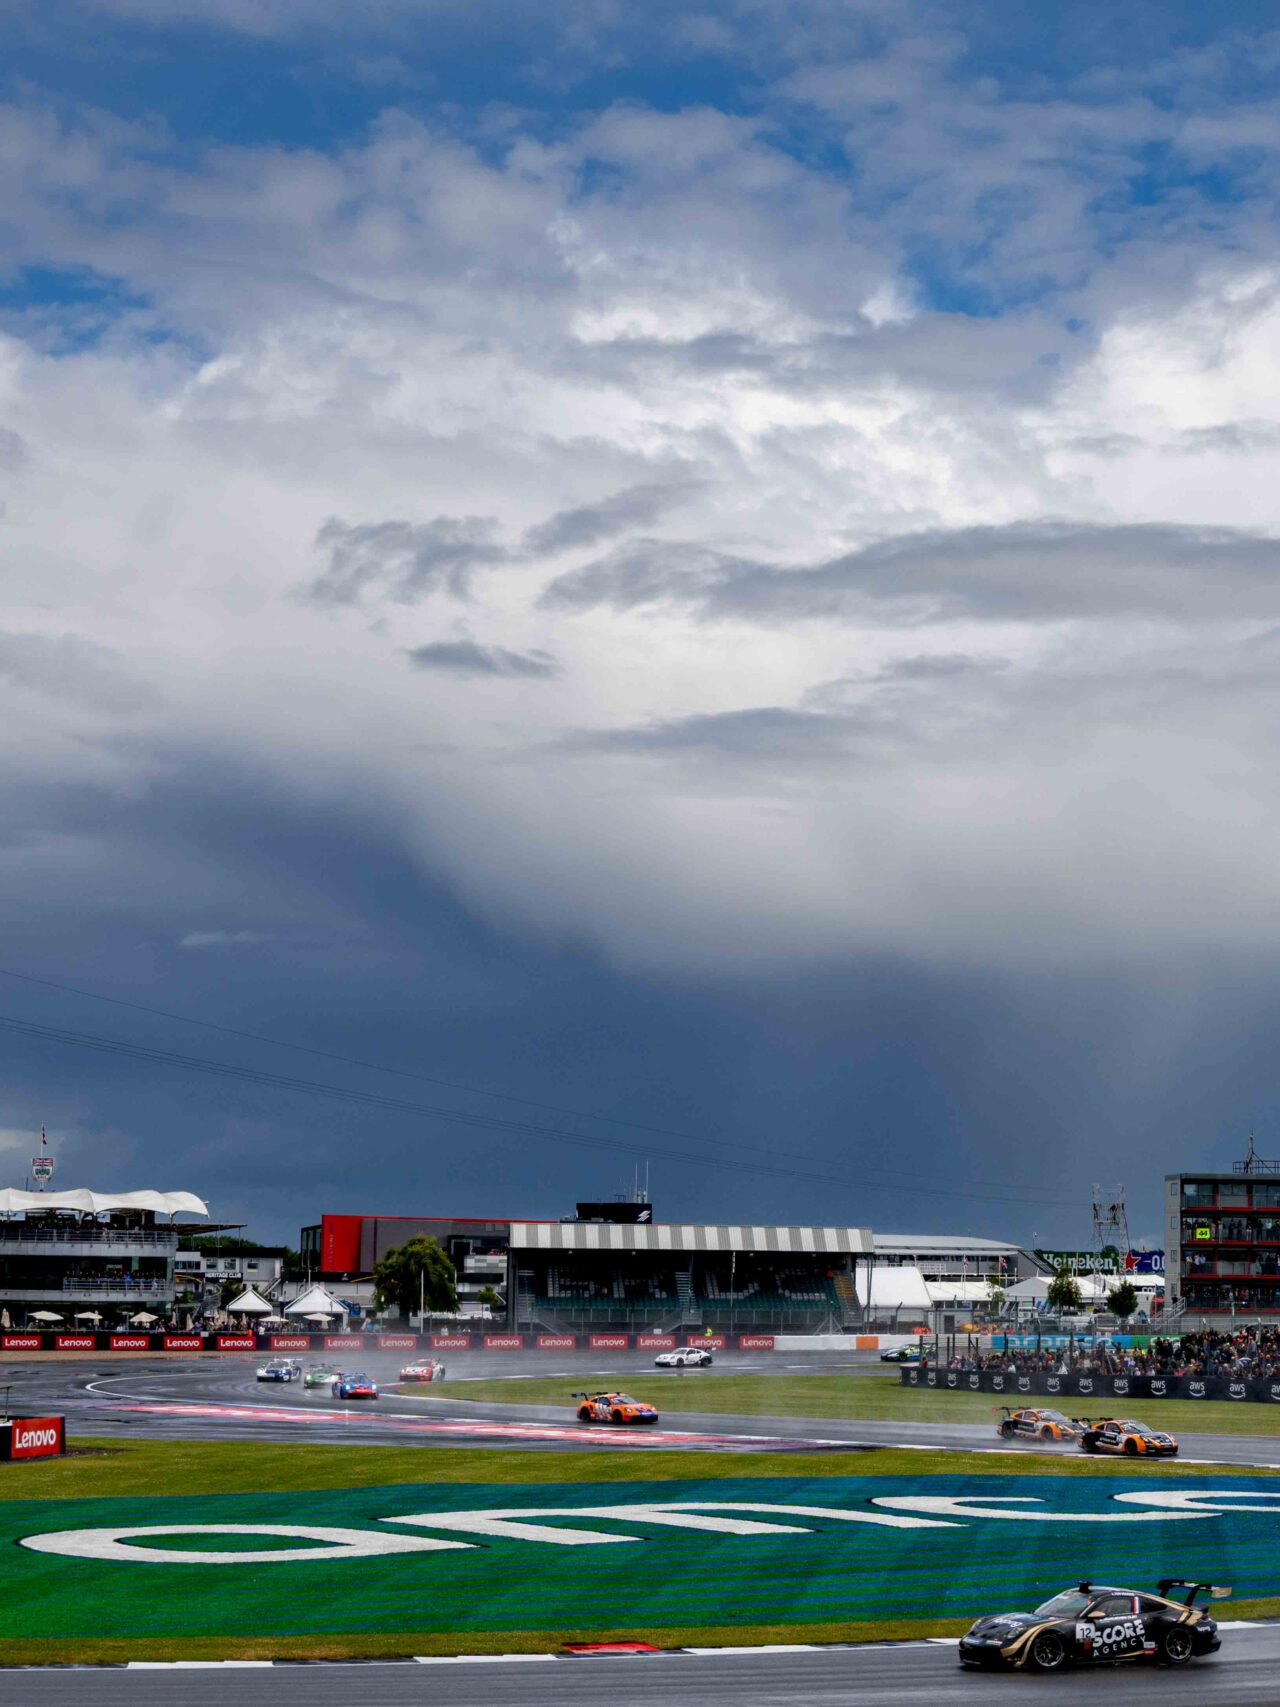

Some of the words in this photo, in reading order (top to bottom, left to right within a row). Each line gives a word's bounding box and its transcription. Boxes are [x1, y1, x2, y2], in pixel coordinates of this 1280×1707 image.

[1043, 1253, 1113, 1270] Heineken
[5, 1339, 37, 1347] Lenovo
[59, 1339, 91, 1347] Lenovo
[113, 1339, 145, 1347] Lenovo
[167, 1339, 199, 1347] Lenovo
[220, 1339, 253, 1347] Lenovo
[274, 1339, 307, 1347] Lenovo
[327, 1339, 360, 1347] Lenovo
[381, 1339, 413, 1347] Lenovo
[434, 1339, 466, 1347] Lenovo
[487, 1339, 519, 1347] Lenovo
[540, 1339, 572, 1347] Lenovo
[592, 1339, 624, 1347] Lenovo
[640, 1339, 672, 1347] Lenovo
[690, 1339, 722, 1347] Lenovo
[743, 1339, 772, 1347] Lenovo
[15, 1428, 57, 1448] Lenovo
[1079, 1627, 1092, 1638] 12
[1092, 1619, 1146, 1648] SCORE
[1093, 1635, 1146, 1657] AGENCY
